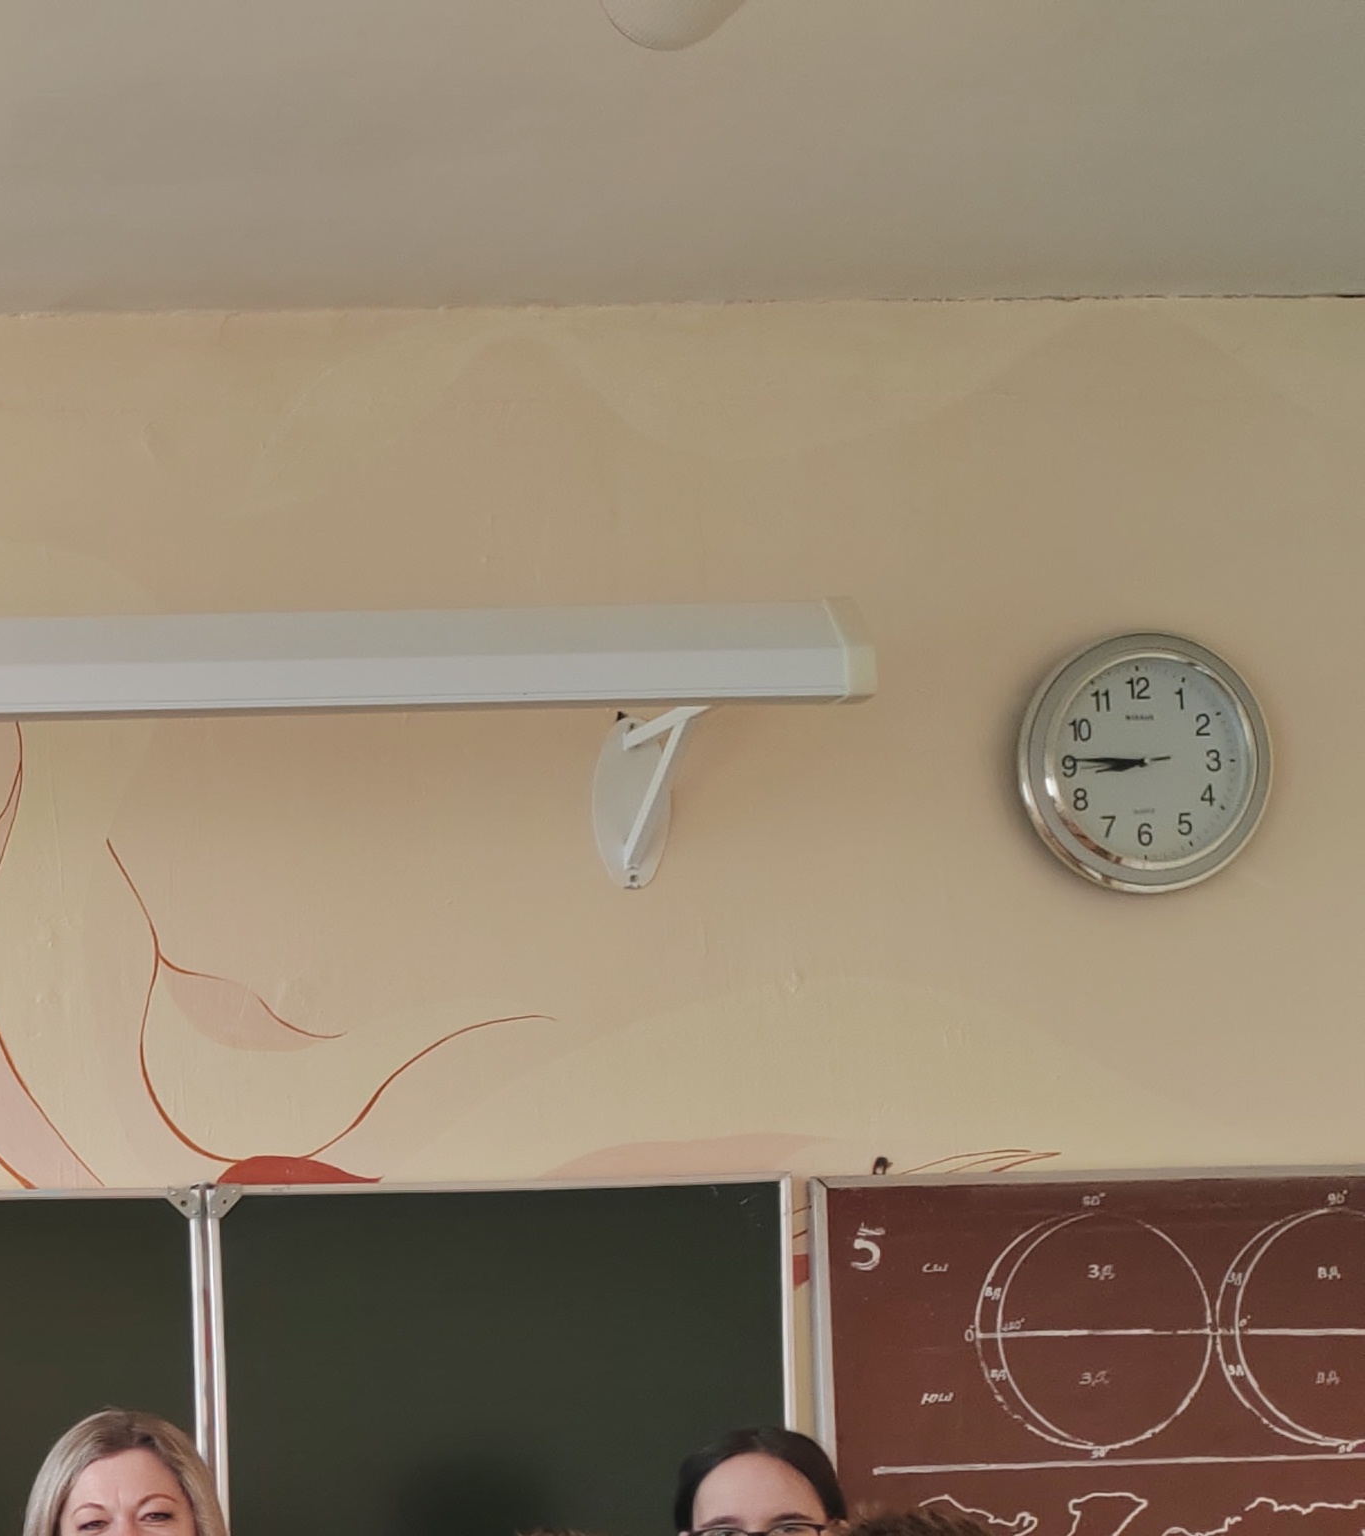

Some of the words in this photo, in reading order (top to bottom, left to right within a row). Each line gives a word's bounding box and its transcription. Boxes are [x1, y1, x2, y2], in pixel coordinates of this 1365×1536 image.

[1125, 677, 1151, 700] 12
[1174, 688, 1185, 710] 1
[1091, 689, 1111, 712] 11
[1069, 719, 1091, 741] 10
[1196, 714, 1210, 736] 2
[1062, 755, 1077, 778] 9
[1206, 750, 1221, 772] 3
[1073, 788, 1088, 811] 8
[1200, 784, 1215, 806] 4
[1101, 815, 1116, 838] 7
[1137, 823, 1152, 846] 6
[1177, 813, 1192, 835] 5
[851, 1222, 886, 1271] 5
